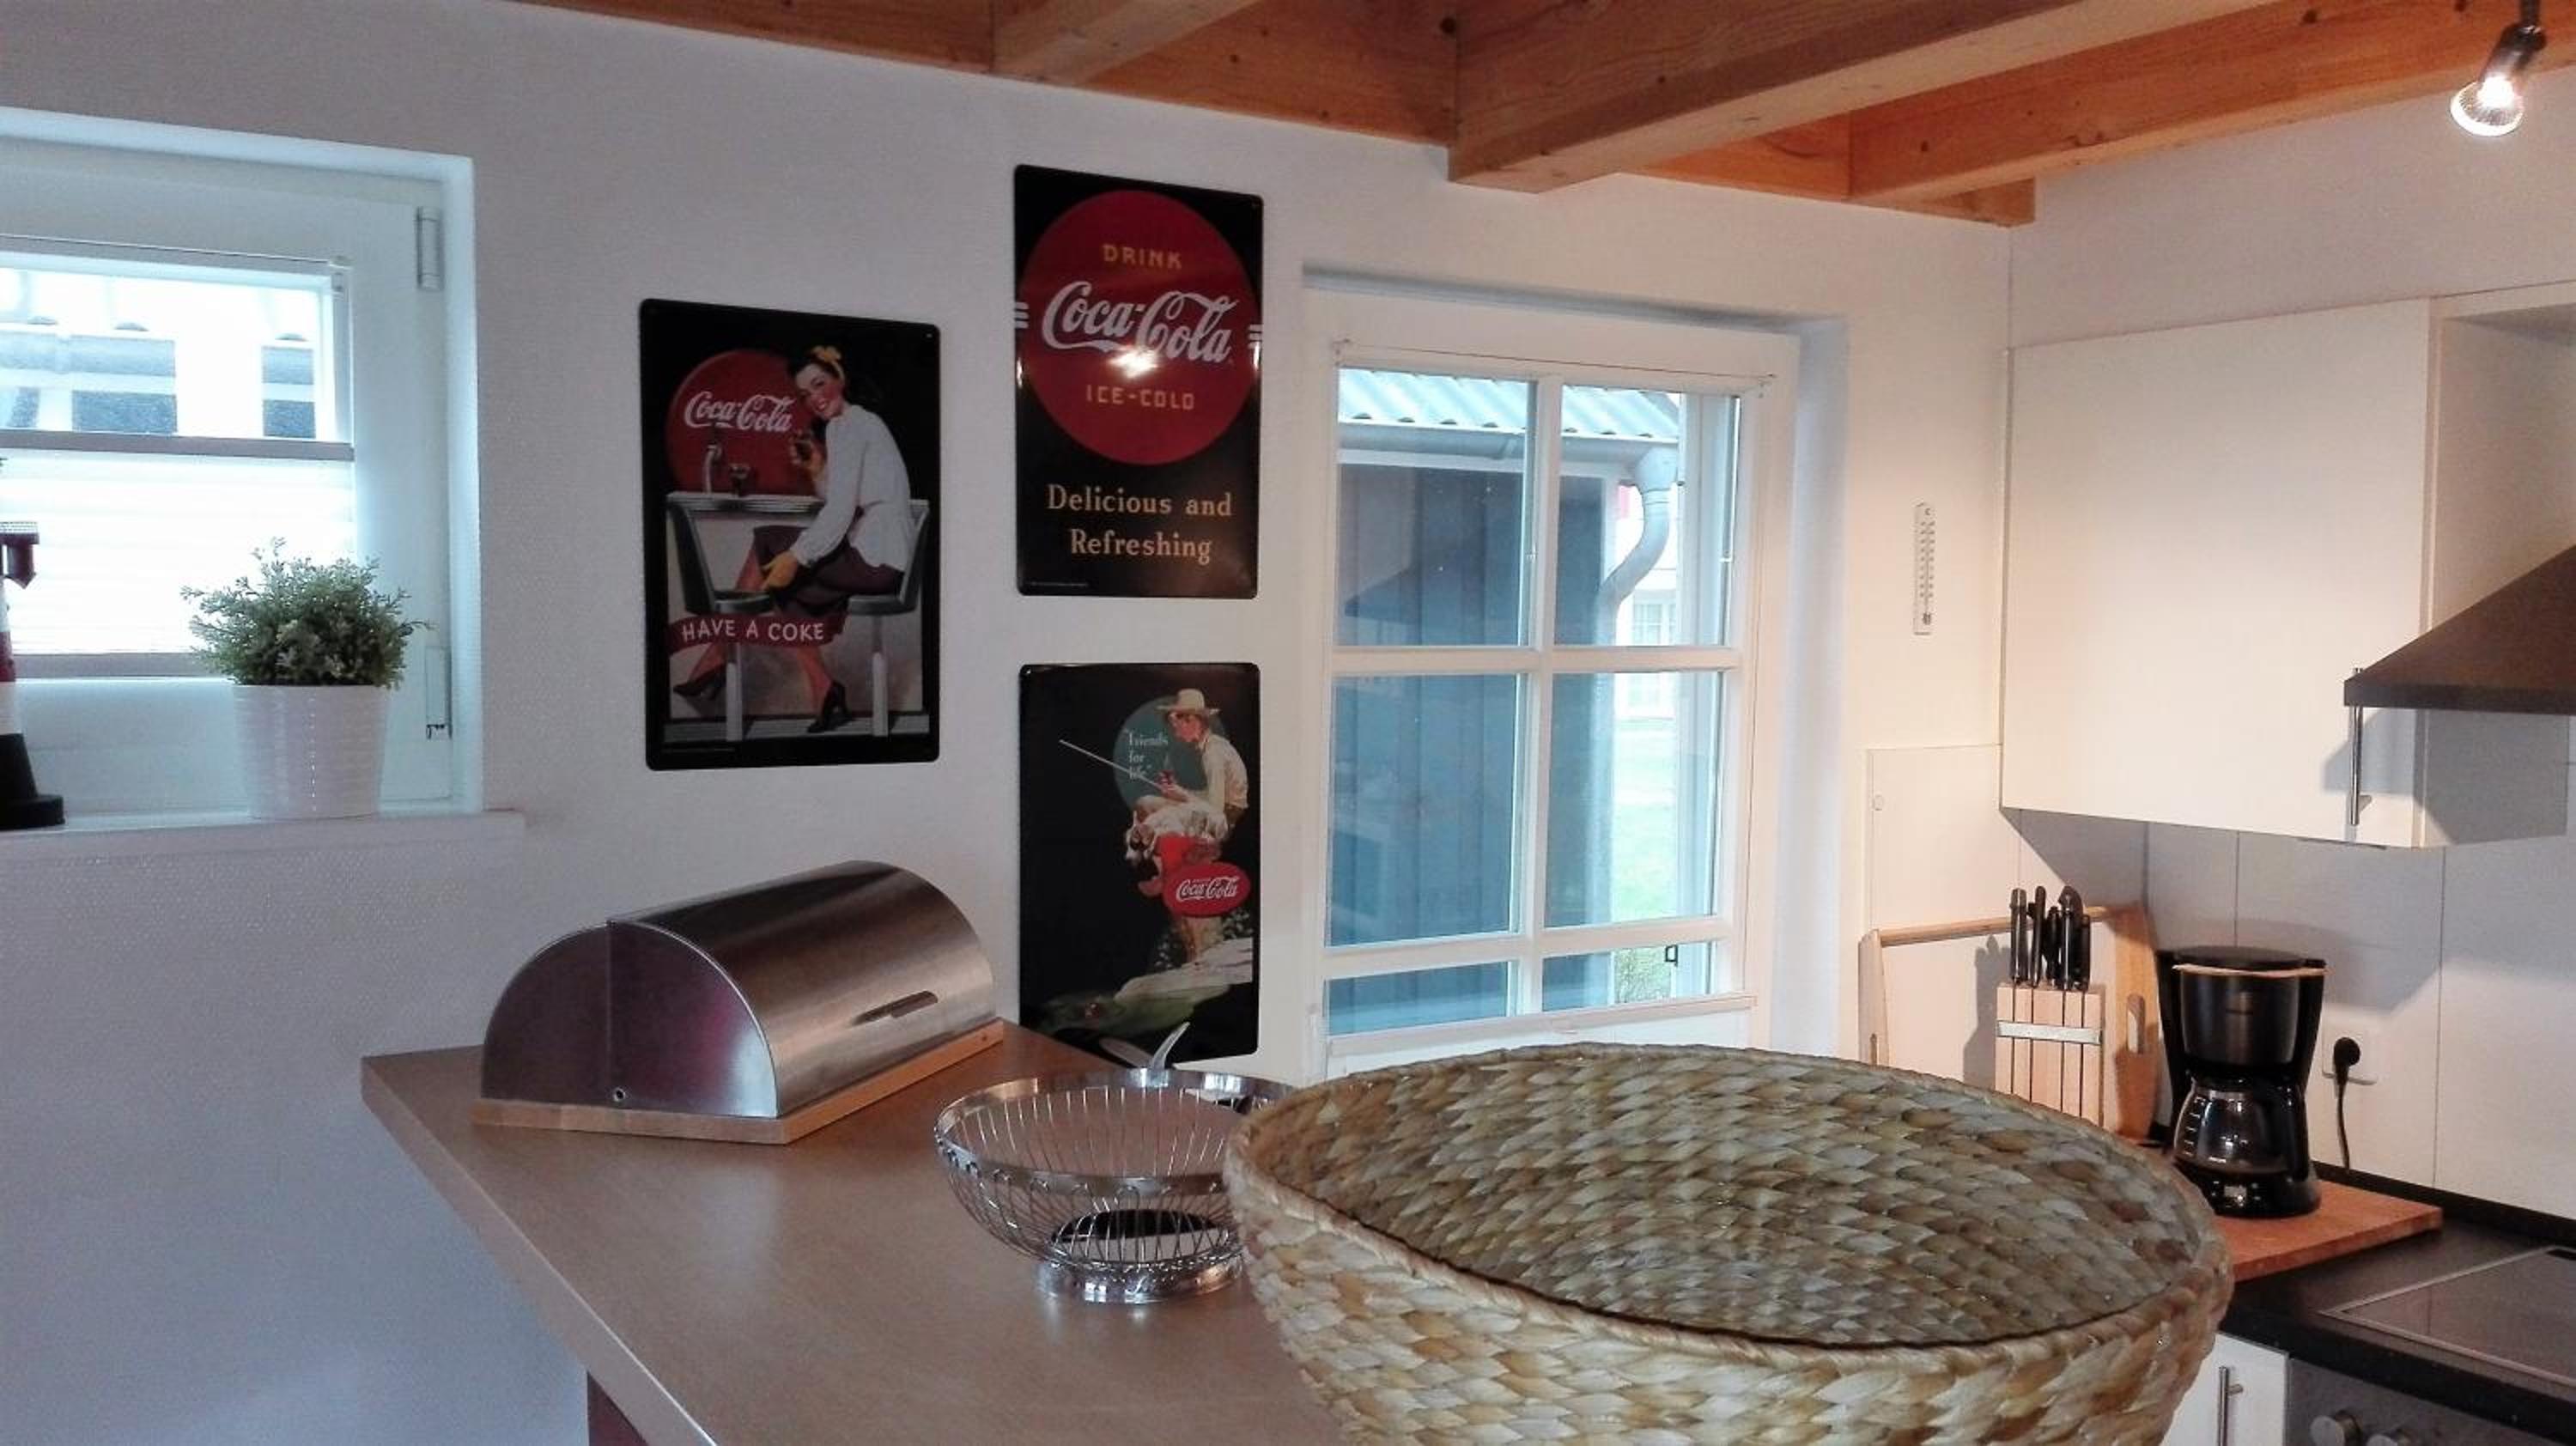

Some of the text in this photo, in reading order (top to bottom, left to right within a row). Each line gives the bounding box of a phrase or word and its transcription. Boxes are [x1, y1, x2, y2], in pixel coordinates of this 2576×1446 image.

[1102, 244, 1182, 270] DRINK
[1042, 280, 1240, 363] Coca-Cola
[684, 391, 797, 432] Coca-Cola
[1085, 385, 1194, 410] ICE-COLD
[1047, 483, 1232, 516] Delicious and
[1070, 528, 1212, 566] Refreshing
[682, 618, 825, 642] HAVE A COKE
